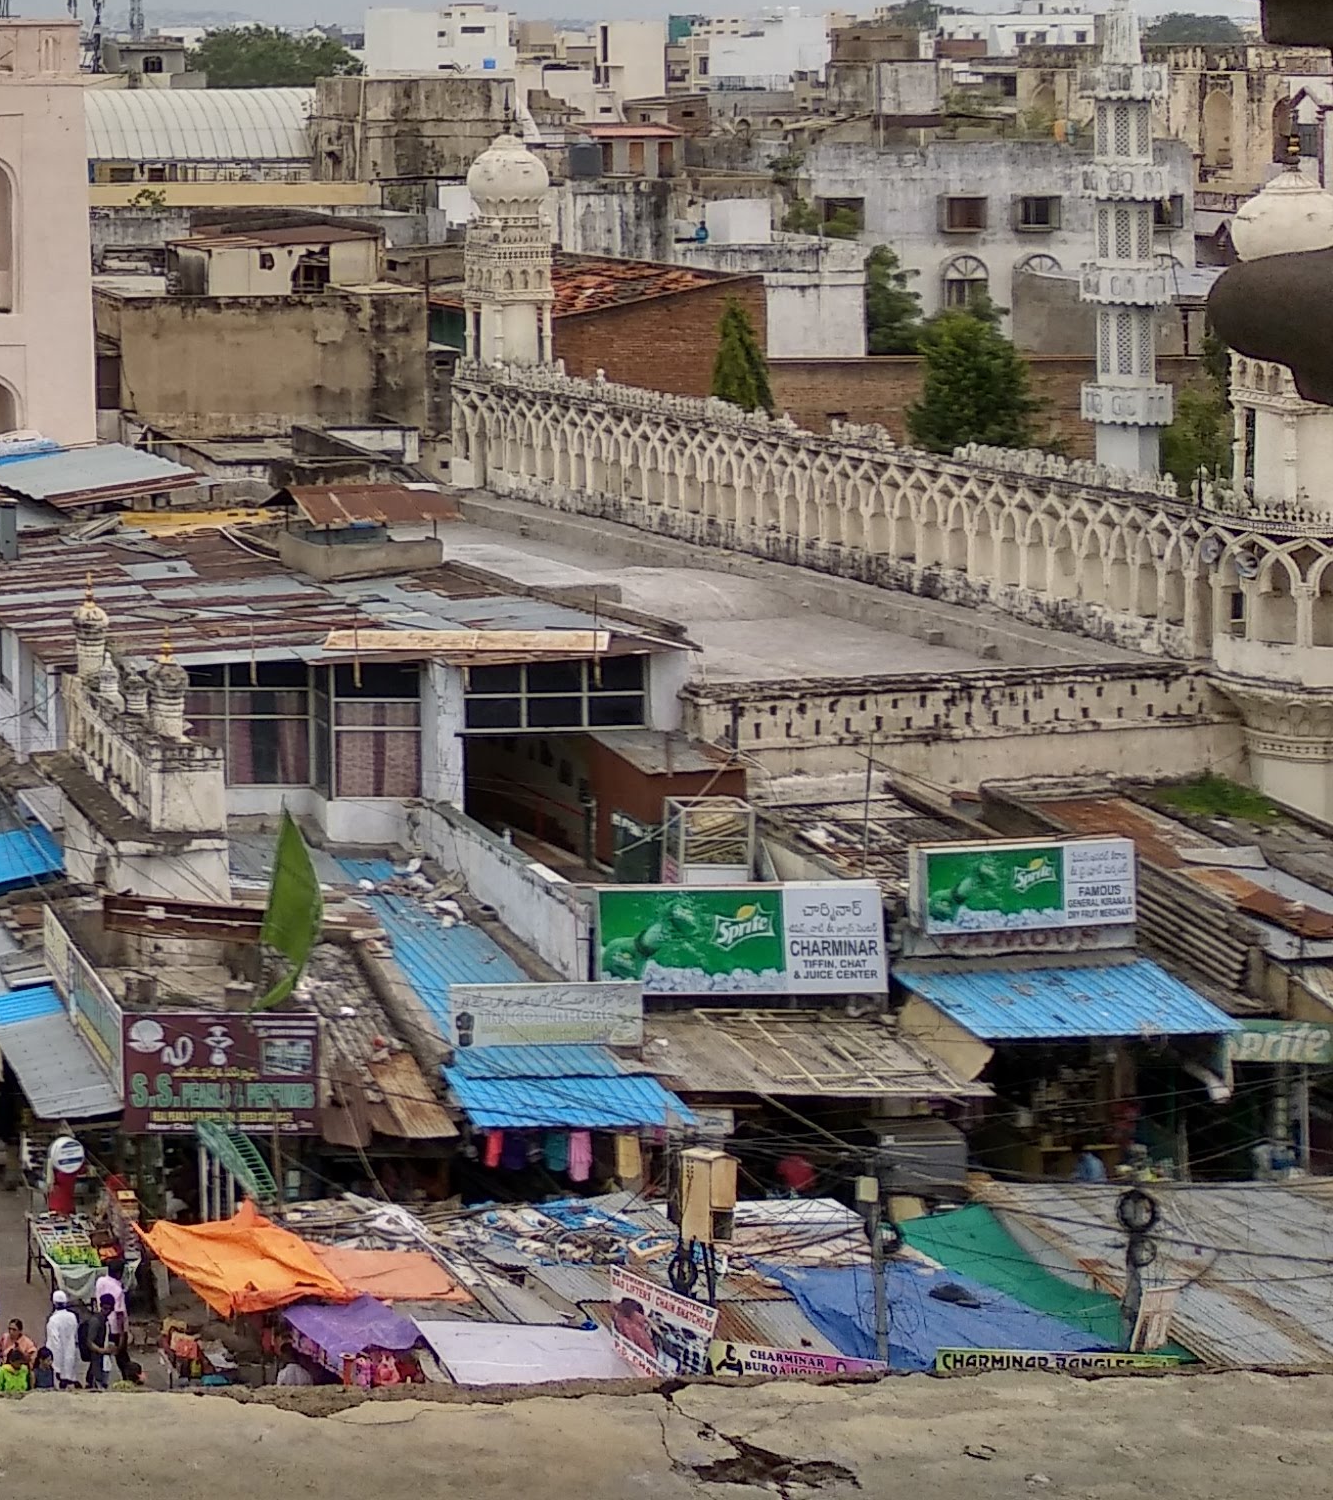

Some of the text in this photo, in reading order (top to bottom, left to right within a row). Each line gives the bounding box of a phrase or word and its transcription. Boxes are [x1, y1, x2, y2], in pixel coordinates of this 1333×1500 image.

[1016, 867, 1052, 886] Sprite
[1078, 885, 1122, 897] FAMOUS
[1067, 898, 1100, 908] GENERAL
[1101, 896, 1126, 906] KIRANA
[1067, 907, 1133, 919] DRY FRUIT MERCHANT
[717, 916, 768, 944] Sprite
[790, 940, 879, 956] CHARMINAR
[803, 959, 867, 969] TIFFIN, CHAT
[793, 970, 878, 979] & JUICE CENTER
[181, 1082, 232, 1109] PEARLS
[246, 1082, 315, 1109] PERFUMES
[625, 1281, 650, 1301] LIFTERS
[655, 1295, 675, 1314] CHAIN
[676, 1305, 713, 1332] SNATCHERS
[749, 1349, 825, 1367] CHARMINAR
[942, 1353, 1050, 1369] CHARMINAR
[745, 1361, 790, 1375] BURQA
